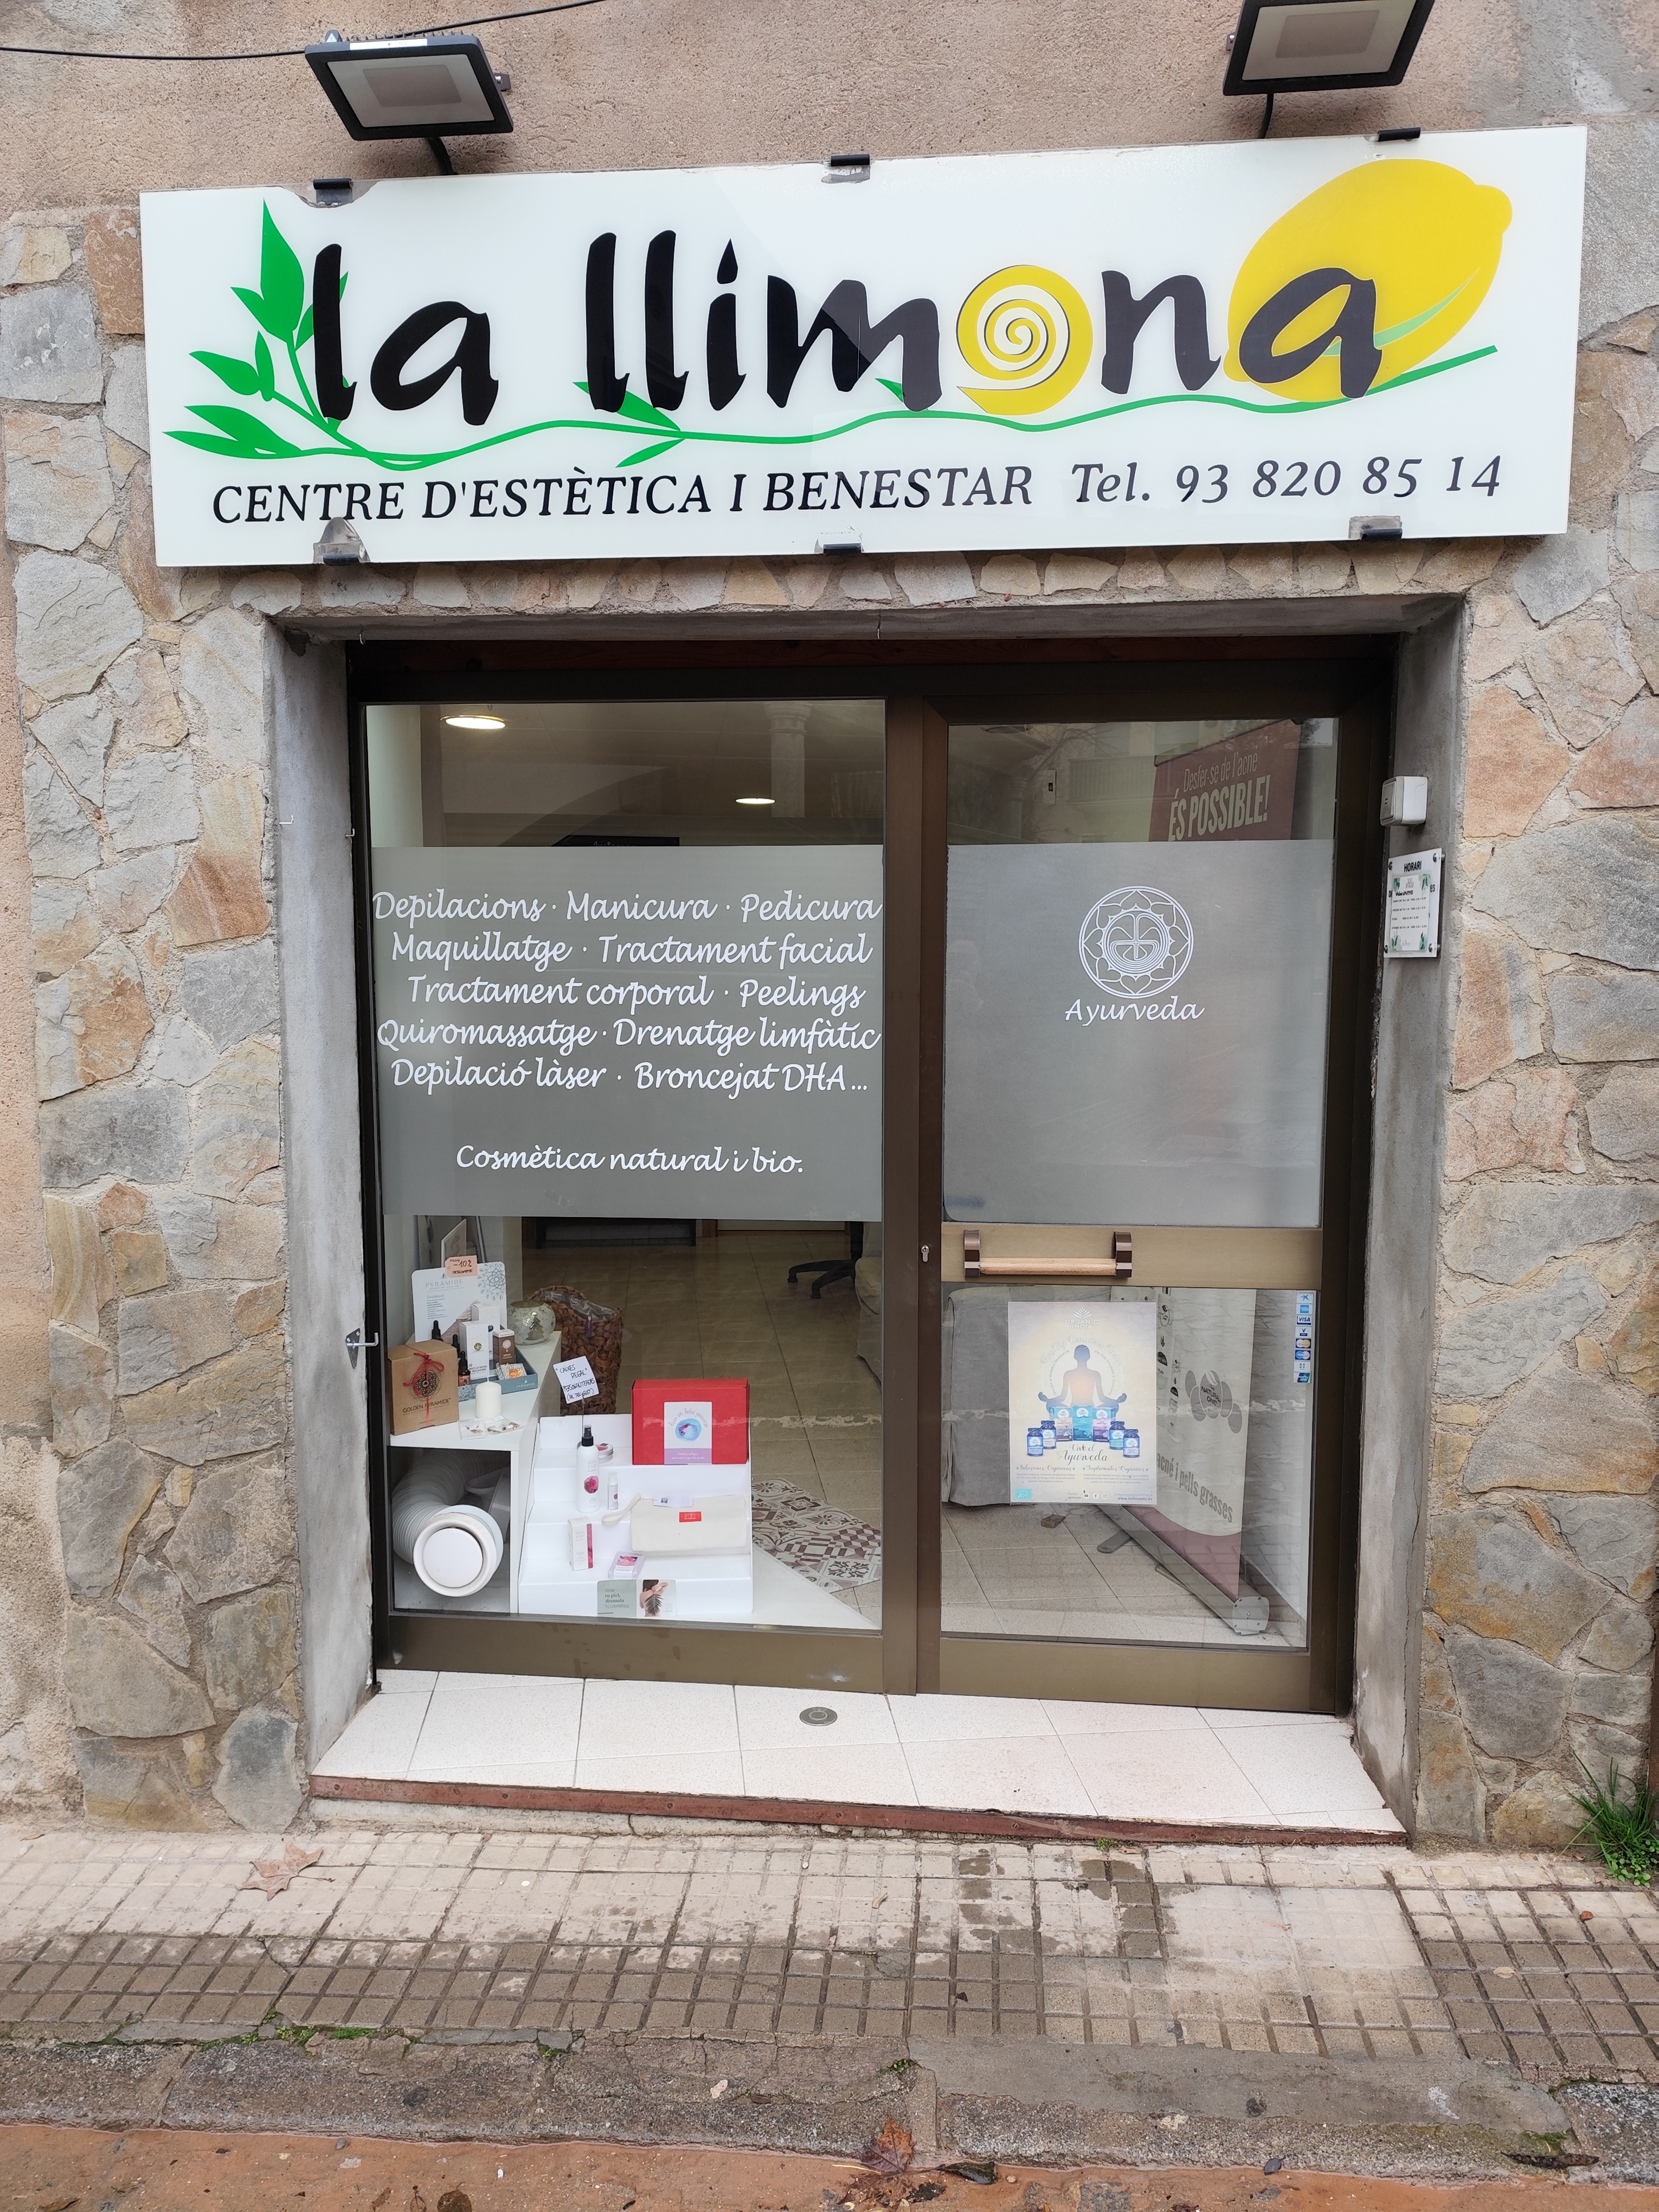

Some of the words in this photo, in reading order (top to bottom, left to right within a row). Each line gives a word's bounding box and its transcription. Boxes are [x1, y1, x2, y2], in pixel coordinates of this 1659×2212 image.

[313, 243, 499, 425] la
[214, 483, 404, 523] CENTRE
[422, 467, 711, 518] D'ESTÈTICA
[730, 474, 747, 511] I
[763, 466, 1031, 511] BENESTAR
[1072, 462, 1149, 502] Tel.
[1177, 465, 1227, 503] 93
[1253, 461, 1340, 497] 820
[1363, 457, 1422, 497] 85
[1446, 456, 1500, 496] 14
[1184, 764, 1219, 792] Desfer-se
[1220, 756, 1231, 781] de
[1232, 744, 1258, 777] l'acné
[1168, 788, 1187, 841] ÉS
[1188, 774, 1270, 838] POSSIBLE!
[1404, 860, 1422, 872] HORARI
[372, 889, 545, 928] Depilacions
[566, 891, 718, 922] Manicura
[741, 890, 882, 922] Pedicura
[391, 931, 572, 972] Maquillatge
[599, 935, 777, 964] Tractament
[779, 933, 874, 969] facial
[407, 976, 582, 1005] Tractament
[586, 976, 713, 1014] corporal
[740, 980, 866, 1017] Peelings
[1065, 995, 1205, 1026] Ayurveda
[377, 1019, 597, 1056] Quiromassatge
[613, 1019, 756, 1056] Drenatge
[758, 1017, 882, 1054] limfàtic
[391, 1057, 532, 1095] Depilació
[536, 1057, 607, 1089] làser
[634, 1063, 781, 1099] Broncejat
[456, 1146, 605, 1171] Cosmètica
[610, 1146, 729, 1171] natural
[732, 1149, 750, 1172] i
[752, 1147, 803, 1173] bio.
[453, 1259, 472, 1268] -10%
[426, 1279, 464, 1288] PYRAMIDE
[403, 1404, 423, 1413] GOLDEN
[1201, 1386, 1221, 1403] NATURAL
[1207, 1396, 1217, 1406] ONE
[1057, 1449, 1109, 1465] Ayurveda
[1088, 1443, 1096, 1451] el
[1157, 1453, 1174, 1477] acné
[1175, 1462, 1179, 1481] i
[1179, 1470, 1198, 1497] pells
[1200, 1486, 1233, 1523] grasses
